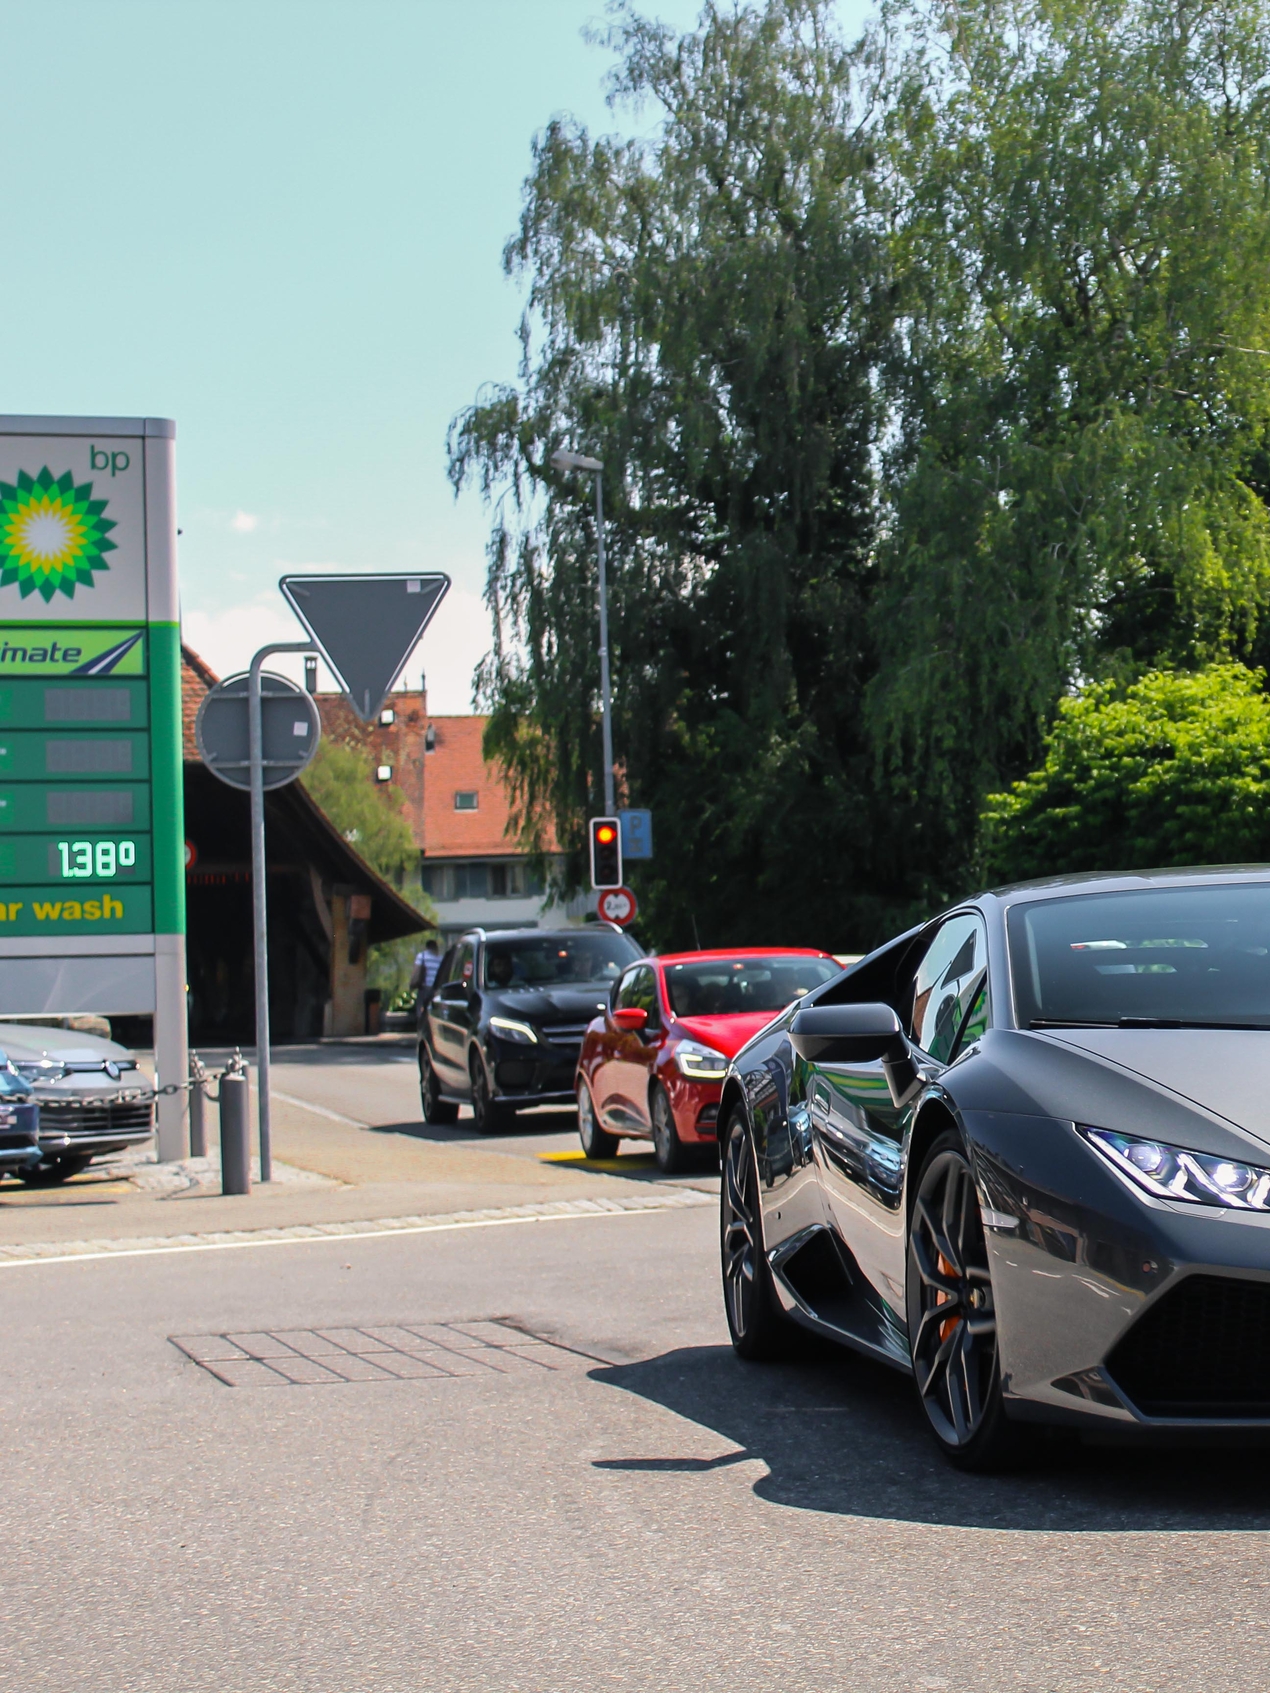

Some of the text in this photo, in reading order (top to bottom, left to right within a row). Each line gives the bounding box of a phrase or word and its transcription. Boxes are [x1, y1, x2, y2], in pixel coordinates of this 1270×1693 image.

[90, 444, 130, 477] bp
[0, 642, 82, 663] imate
[33, 894, 124, 920] wash
